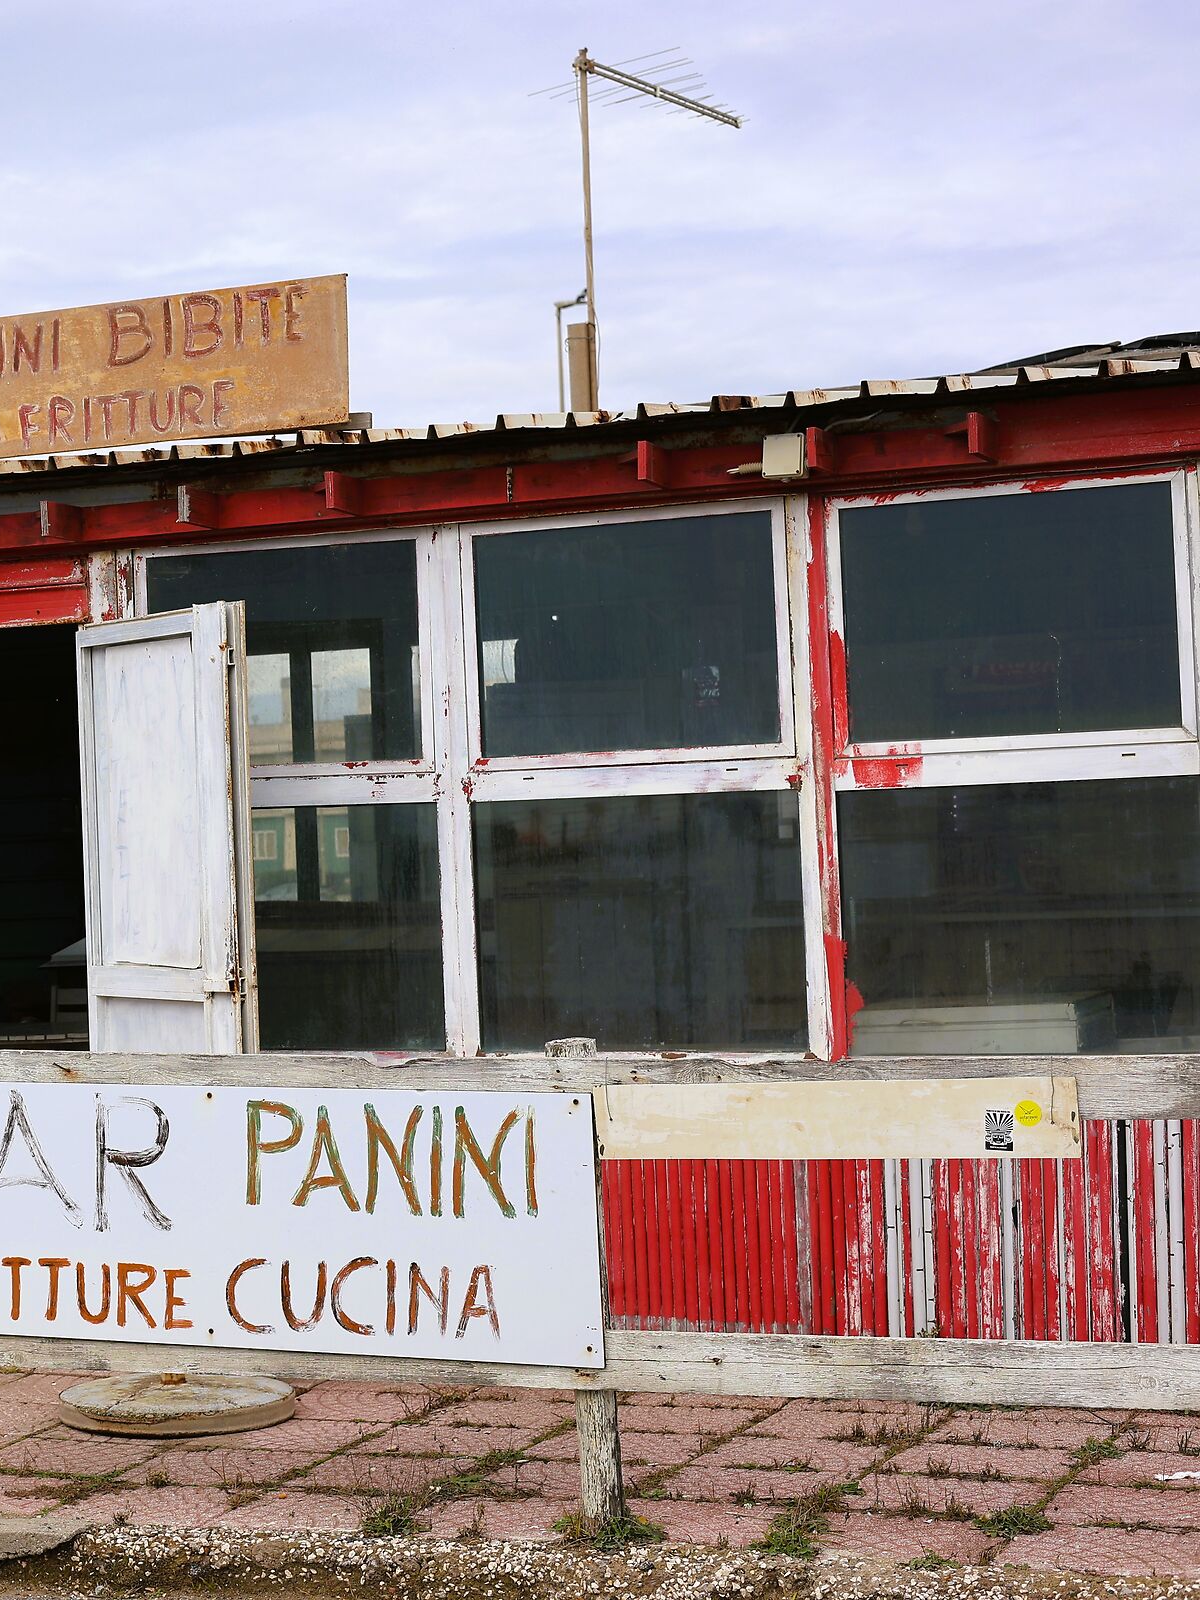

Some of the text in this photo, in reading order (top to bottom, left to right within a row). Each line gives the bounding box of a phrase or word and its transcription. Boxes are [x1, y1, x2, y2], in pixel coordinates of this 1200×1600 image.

[105, 283, 308, 367] BIBITE
[18, 380, 235, 448] FRITTURE
[246, 1099, 539, 1219] PANINI
[225, 1256, 502, 1342] CUCINA
